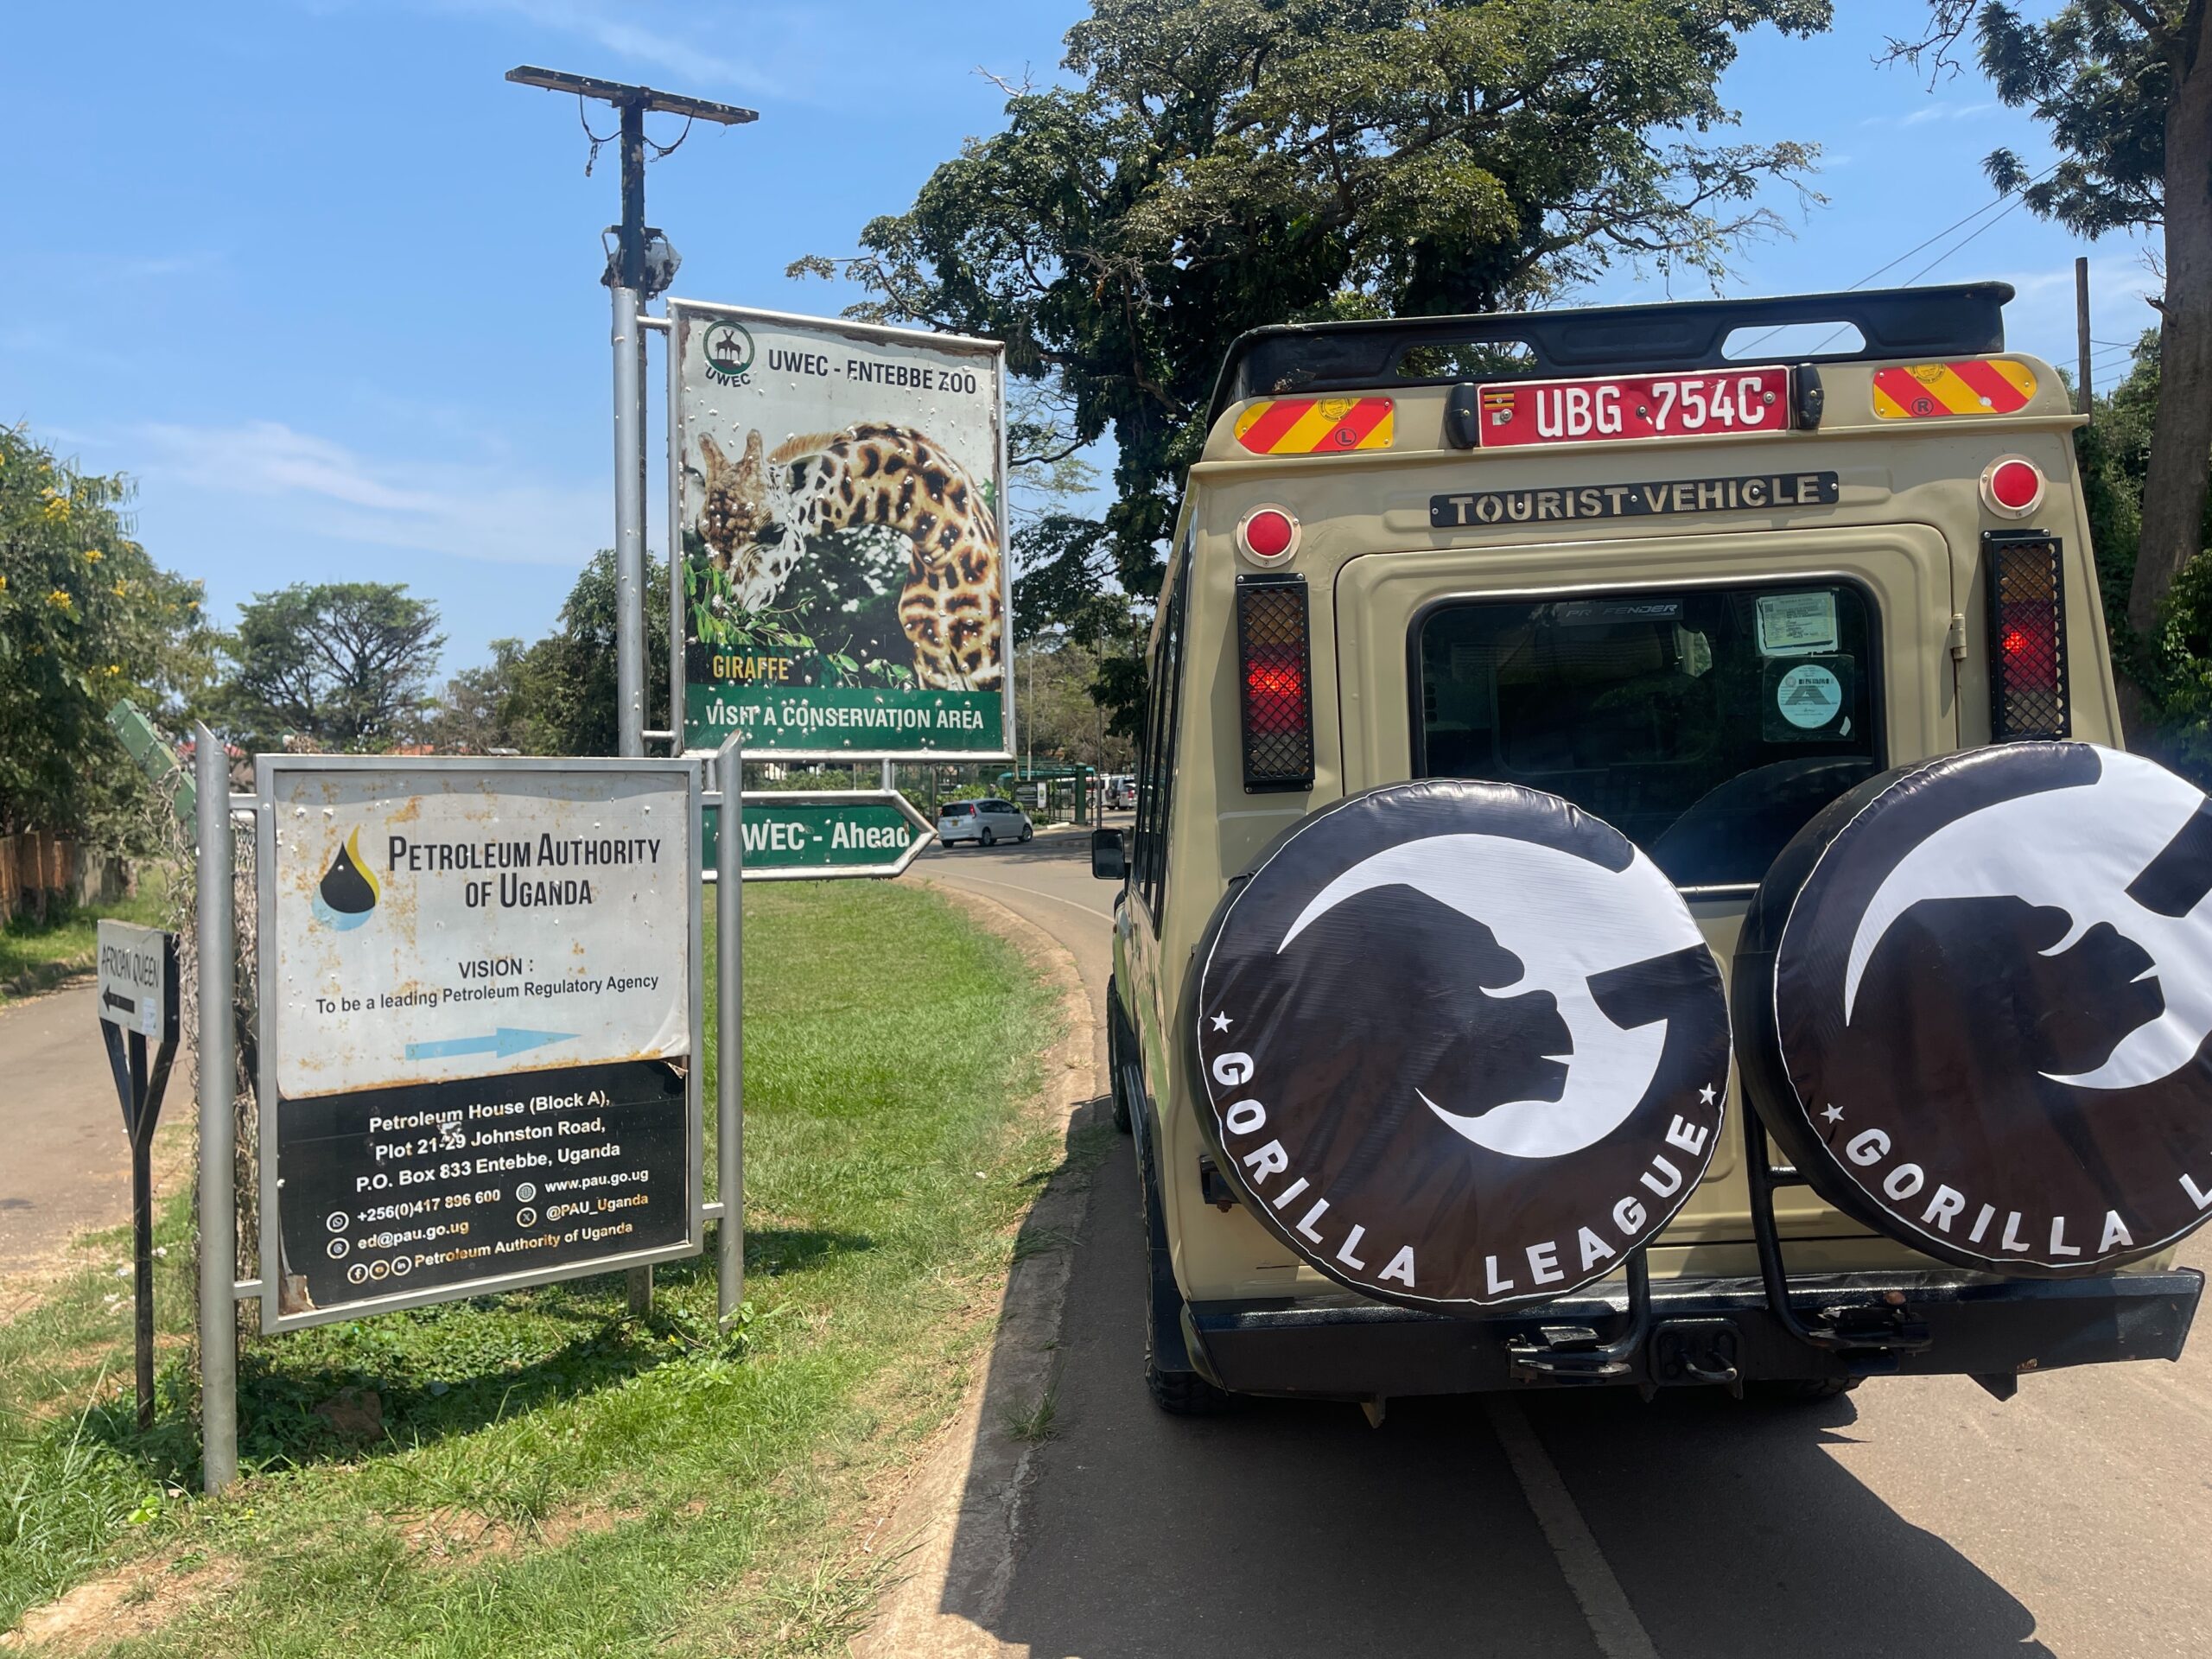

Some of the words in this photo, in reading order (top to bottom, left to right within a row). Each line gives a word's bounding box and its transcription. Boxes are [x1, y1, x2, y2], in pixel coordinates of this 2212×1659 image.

[705, 366, 752, 388] UWEC
[768, 348, 829, 377] UWEC
[847, 359, 933, 390] ENTEBBE
[938, 372, 976, 395] ZOO
[1536, 385, 1624, 438] UBG
[1651, 376, 1765, 432] 754C
[1448, 486, 1630, 525] TOURIST
[1643, 474, 1821, 514] VEHICLE
[713, 654, 790, 681] GIRAFFE
[705, 704, 754, 727] VISIT
[763, 707, 777, 727] A
[783, 707, 931, 729] CONSERVATION
[937, 709, 984, 730] AREA
[389, 836, 531, 871] PETROLEUM
[537, 832, 661, 866] AUTHORITY
[741, 822, 805, 851] WEC
[831, 821, 910, 850] Ahead
[465, 880, 493, 908] OF
[500, 873, 593, 908] UGANDA
[101, 943, 132, 981] AFRICAN
[132, 952, 161, 988] QUEEN
[458, 958, 523, 979] VISION
[316, 999, 335, 1014] To
[341, 997, 361, 1013] be
[366, 1000, 375, 1011] a
[380, 991, 438, 1010] leading
[442, 985, 519, 1004] Petroleum
[524, 979, 602, 999] Regulatory
[607, 976, 658, 995] Agency
[369, 1109, 463, 1133] Petroleum
[468, 1101, 524, 1120] House
[529, 1093, 583, 1115] (Block
[586, 1090, 611, 1108] A),
[375, 1140, 413, 1160] Plot
[470, 1125, 553, 1147] Johnston
[558, 1118, 606, 1136] Road,
[356, 1173, 393, 1193] P.O.
[399, 1167, 435, 1186] Box
[439, 1160, 472, 1179] 833
[476, 1153, 552, 1174] Entebbe,
[557, 1142, 620, 1166] Uganda
[544, 1168, 649, 1193] www.pau.go.ug
[1212, 1051, 1415, 1288] GORILLA
[1485, 1114, 1709, 1295] LEAGUE
[357, 1196, 440, 1223] +256(0)417
[444, 1192, 472, 1210] 896
[474, 1189, 501, 1205] 600
[546, 1193, 649, 1221] @PAU_Uganda
[1846, 1128, 2134, 1255] GORILLA
[358, 1220, 469, 1250] ed@pau.go.ug
[415, 1245, 492, 1268] Petroleum
[494, 1233, 561, 1257] Authority
[564, 1230, 579, 1243] of
[582, 1221, 632, 1243] Uganda
